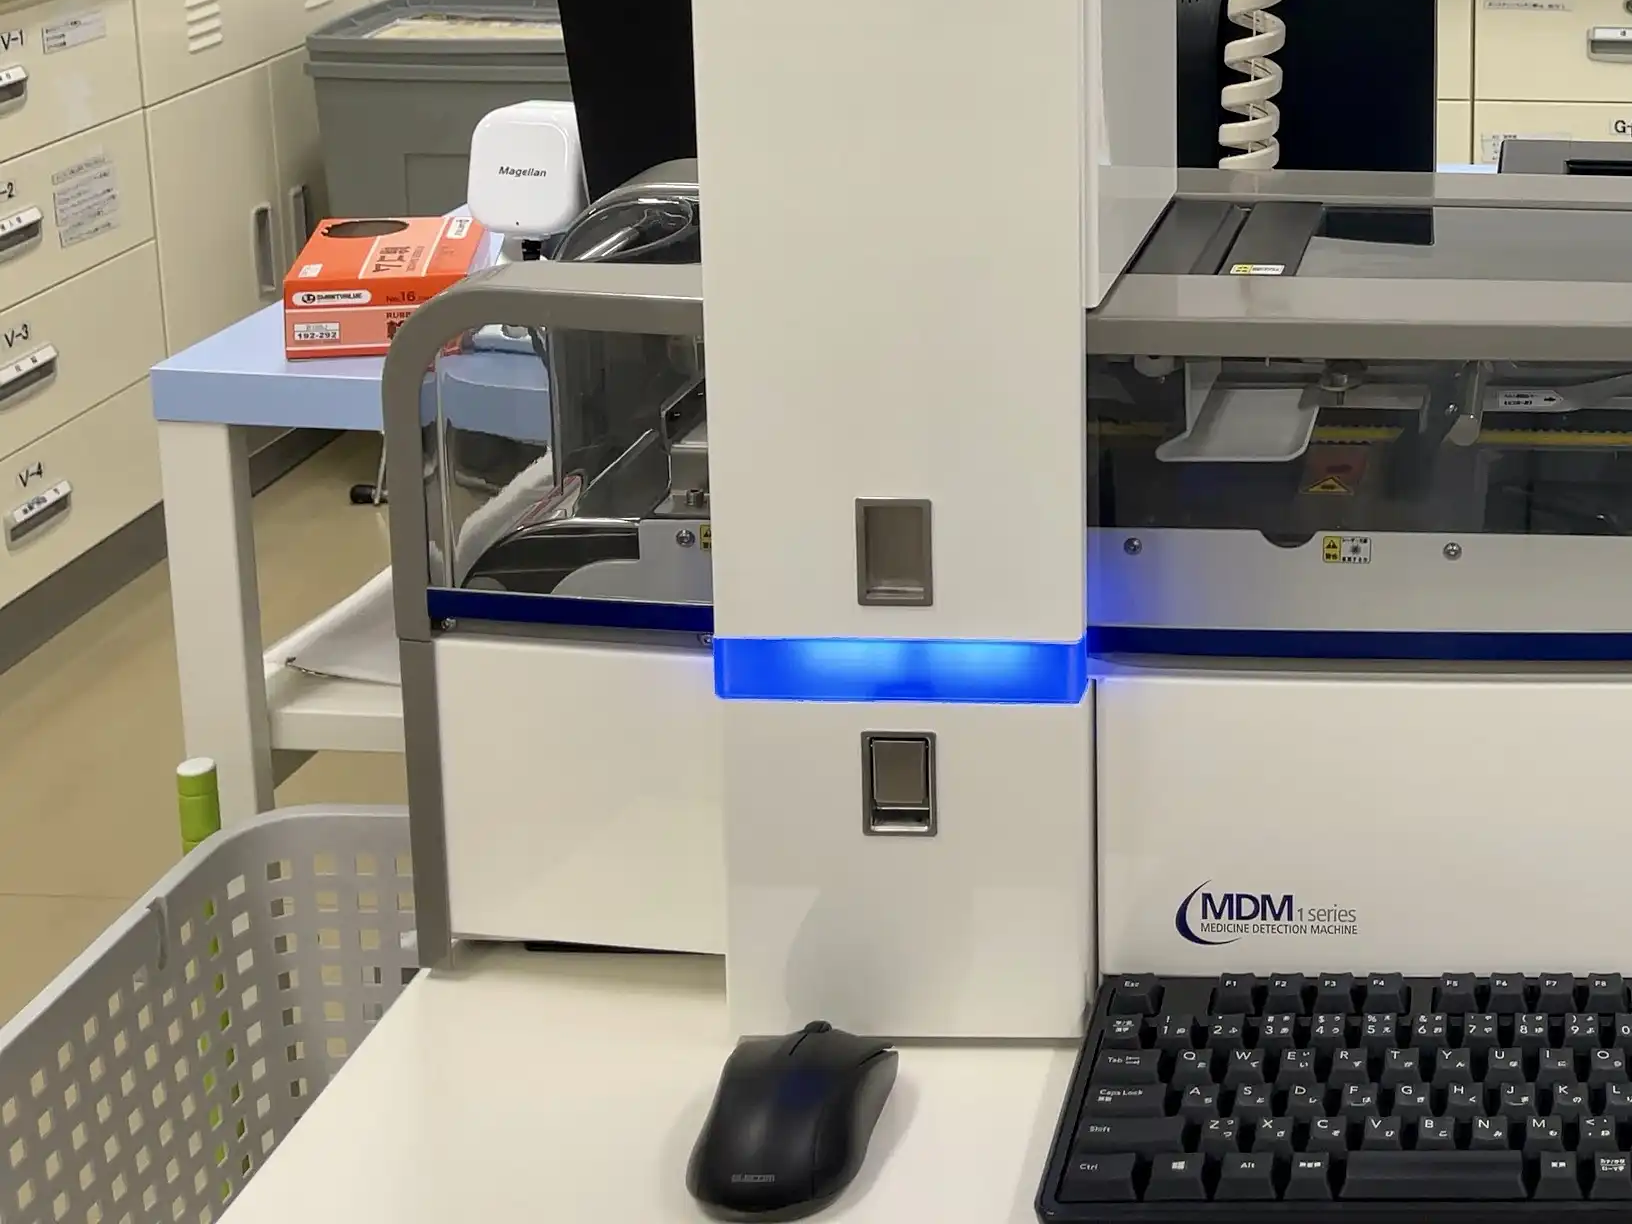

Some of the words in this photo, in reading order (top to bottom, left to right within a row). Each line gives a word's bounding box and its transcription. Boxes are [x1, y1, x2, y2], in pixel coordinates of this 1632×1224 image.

[2, 30, 24, 51] V-1
[498, 166, 547, 177] Magellan
[4, 324, 29, 348] V-3
[19, 462, 43, 487] V-4
[1201, 893, 1294, 922] MDM
[1308, 904, 1357, 923] series
[1200, 923, 1250, 934] MEDICINE
[1252, 924, 1307, 934] DETECTION
[1310, 925, 1358, 935] MACHINE
[1214, 1026, 1222, 1034] 2
[1265, 1026, 1274, 1034] 3
[1316, 1026, 1324, 1034] 4
[1418, 1026, 1426, 1034] 6
[1520, 1026, 1528, 1034] 8
[1571, 1026, 1579, 1034] 9
[1184, 1052, 1196, 1061] Q
[1236, 1052, 1251, 1060] W
[1288, 1052, 1296, 1060] E
[1340, 1051, 1349, 1059] R
[1391, 1051, 1400, 1059] T
[1442, 1051, 1452, 1059] Y
[1495, 1051, 1504, 1059] U
[1100, 1089, 1121, 1097] Caps
[1189, 1087, 1200, 1095] A
[1243, 1087, 1252, 1095] S
[1350, 1086, 1358, 1094] F
[1401, 1086, 1412, 1094] G
[1454, 1086, 1464, 1094] H
[1507, 1086, 1514, 1094] J
[1559, 1086, 1568, 1094] K
[1613, 1085, 1620, 1094] L
[1210, 1120, 1219, 1128] Z
[1262, 1120, 1273, 1128] X
[1317, 1120, 1328, 1128] C
[1371, 1120, 1382, 1128] V
[1425, 1120, 1434, 1128] B
[1479, 1120, 1489, 1128] N
[1532, 1119, 1545, 1128] M
